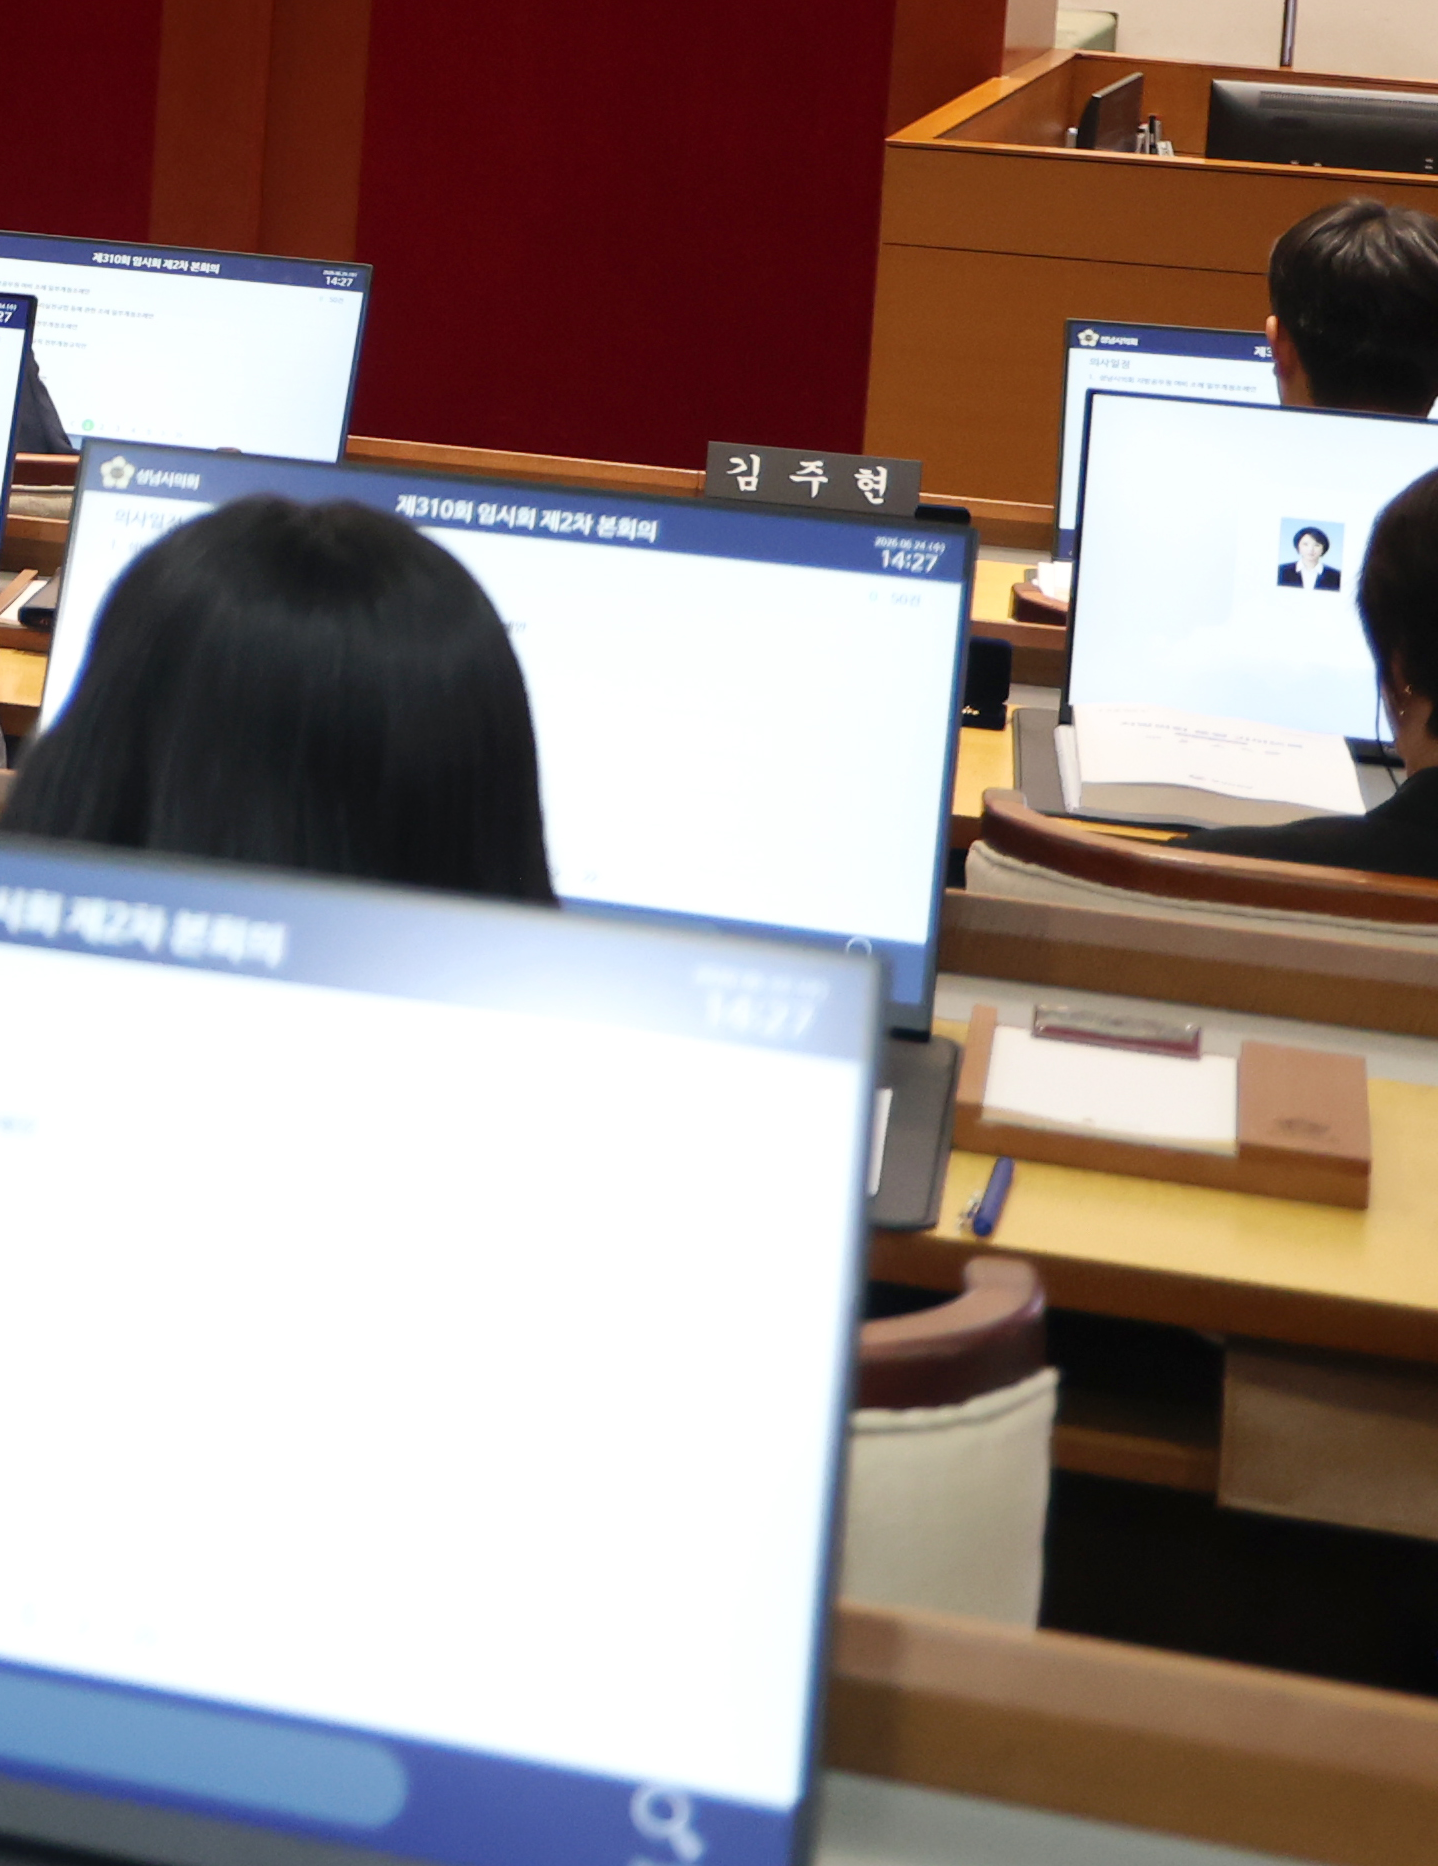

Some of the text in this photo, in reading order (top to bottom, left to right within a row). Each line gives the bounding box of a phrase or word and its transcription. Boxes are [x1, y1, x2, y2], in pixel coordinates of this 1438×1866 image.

[92, 251, 220, 274] 제310회 임시회 제2차 본회의
[325, 276, 353, 287] 14:27
[1100, 336, 1138, 346] 성남시의회
[1089, 357, 1130, 370] 의사일정
[136, 466, 200, 492] 성남시의회
[727, 453, 889, 504] 김주현
[395, 493, 659, 542] 제310회 임시회 제2차 본회의
[881, 549, 938, 573] 14:27
[66, 893, 169, 956] 제2차
[171, 907, 287, 970] 본회의
